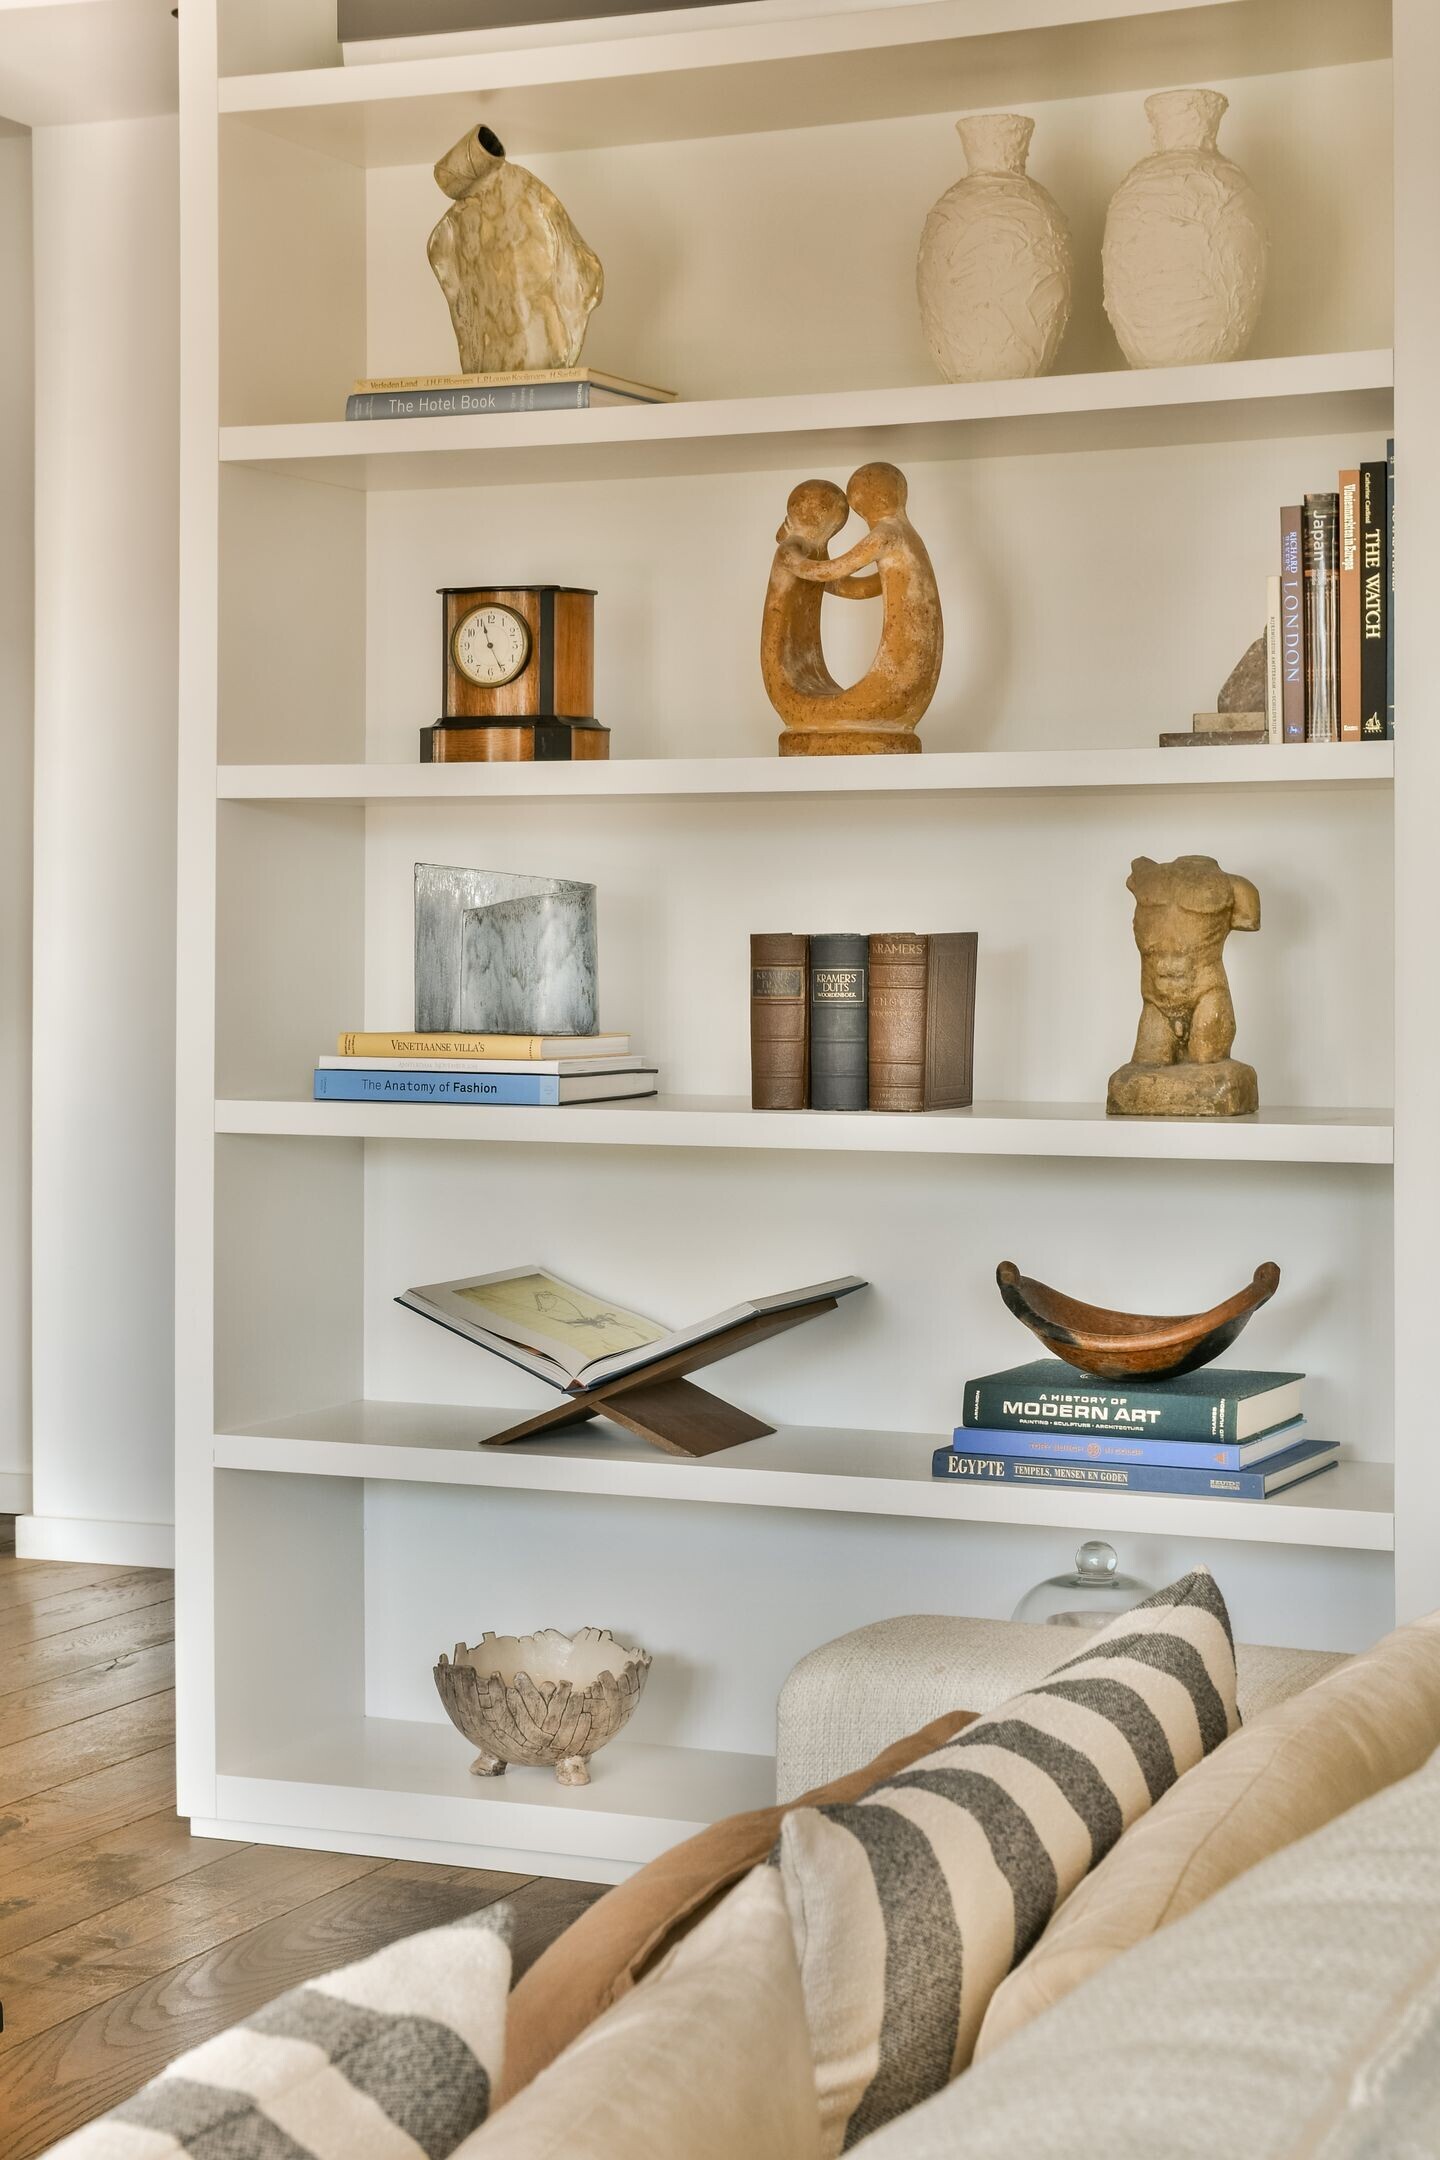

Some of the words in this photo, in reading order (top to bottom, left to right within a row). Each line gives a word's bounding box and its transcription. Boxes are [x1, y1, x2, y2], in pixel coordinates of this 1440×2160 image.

[400, 380, 418, 388] Land
[389, 398, 414, 414] The
[419, 395, 456, 412] Hotel
[461, 393, 496, 409] Book
[1343, 484, 1356, 538] Vlooienmarkten
[1311, 510, 1327, 561] Japan
[1289, 532, 1298, 573] RICHARD
[1342, 545, 1356, 571] Europa
[1365, 529, 1381, 568] THE
[1365, 572, 1381, 639] WATCH
[487, 614, 495, 624] 12
[467, 628, 475, 638] 10
[1284, 581, 1299, 682] LONDON
[816, 974, 857, 984] KRAMERS
[822, 983, 850, 992] DUITS
[391, 1039, 452, 1053] VENETIAANSE
[454, 1042, 485, 1053] VILLA'S
[361, 1079, 381, 1091] The
[384, 1080, 436, 1094] Anatomy
[439, 1082, 451, 1092] of
[453, 1082, 498, 1094] Fashion
[1039, 1393, 1048, 1401] A
[1051, 1394, 1107, 1405] HISTORY
[1111, 1397, 1127, 1405] OF
[1002, 1400, 1108, 1421] MODERN
[1113, 1409, 1161, 1424] ART
[1019, 1418, 1049, 1426] PAINTING
[1053, 1420, 1091, 1428] SCULPTURE
[1095, 1423, 1144, 1432] ARCHITECTURE
[948, 1455, 1005, 1477] EGYPTE
[1014, 1465, 1052, 1477] TEMPELS,
[1055, 1469, 1085, 1480] MENSEN
[1088, 1472, 1099, 1481] EN
[1100, 1471, 1128, 1483] GODEN
